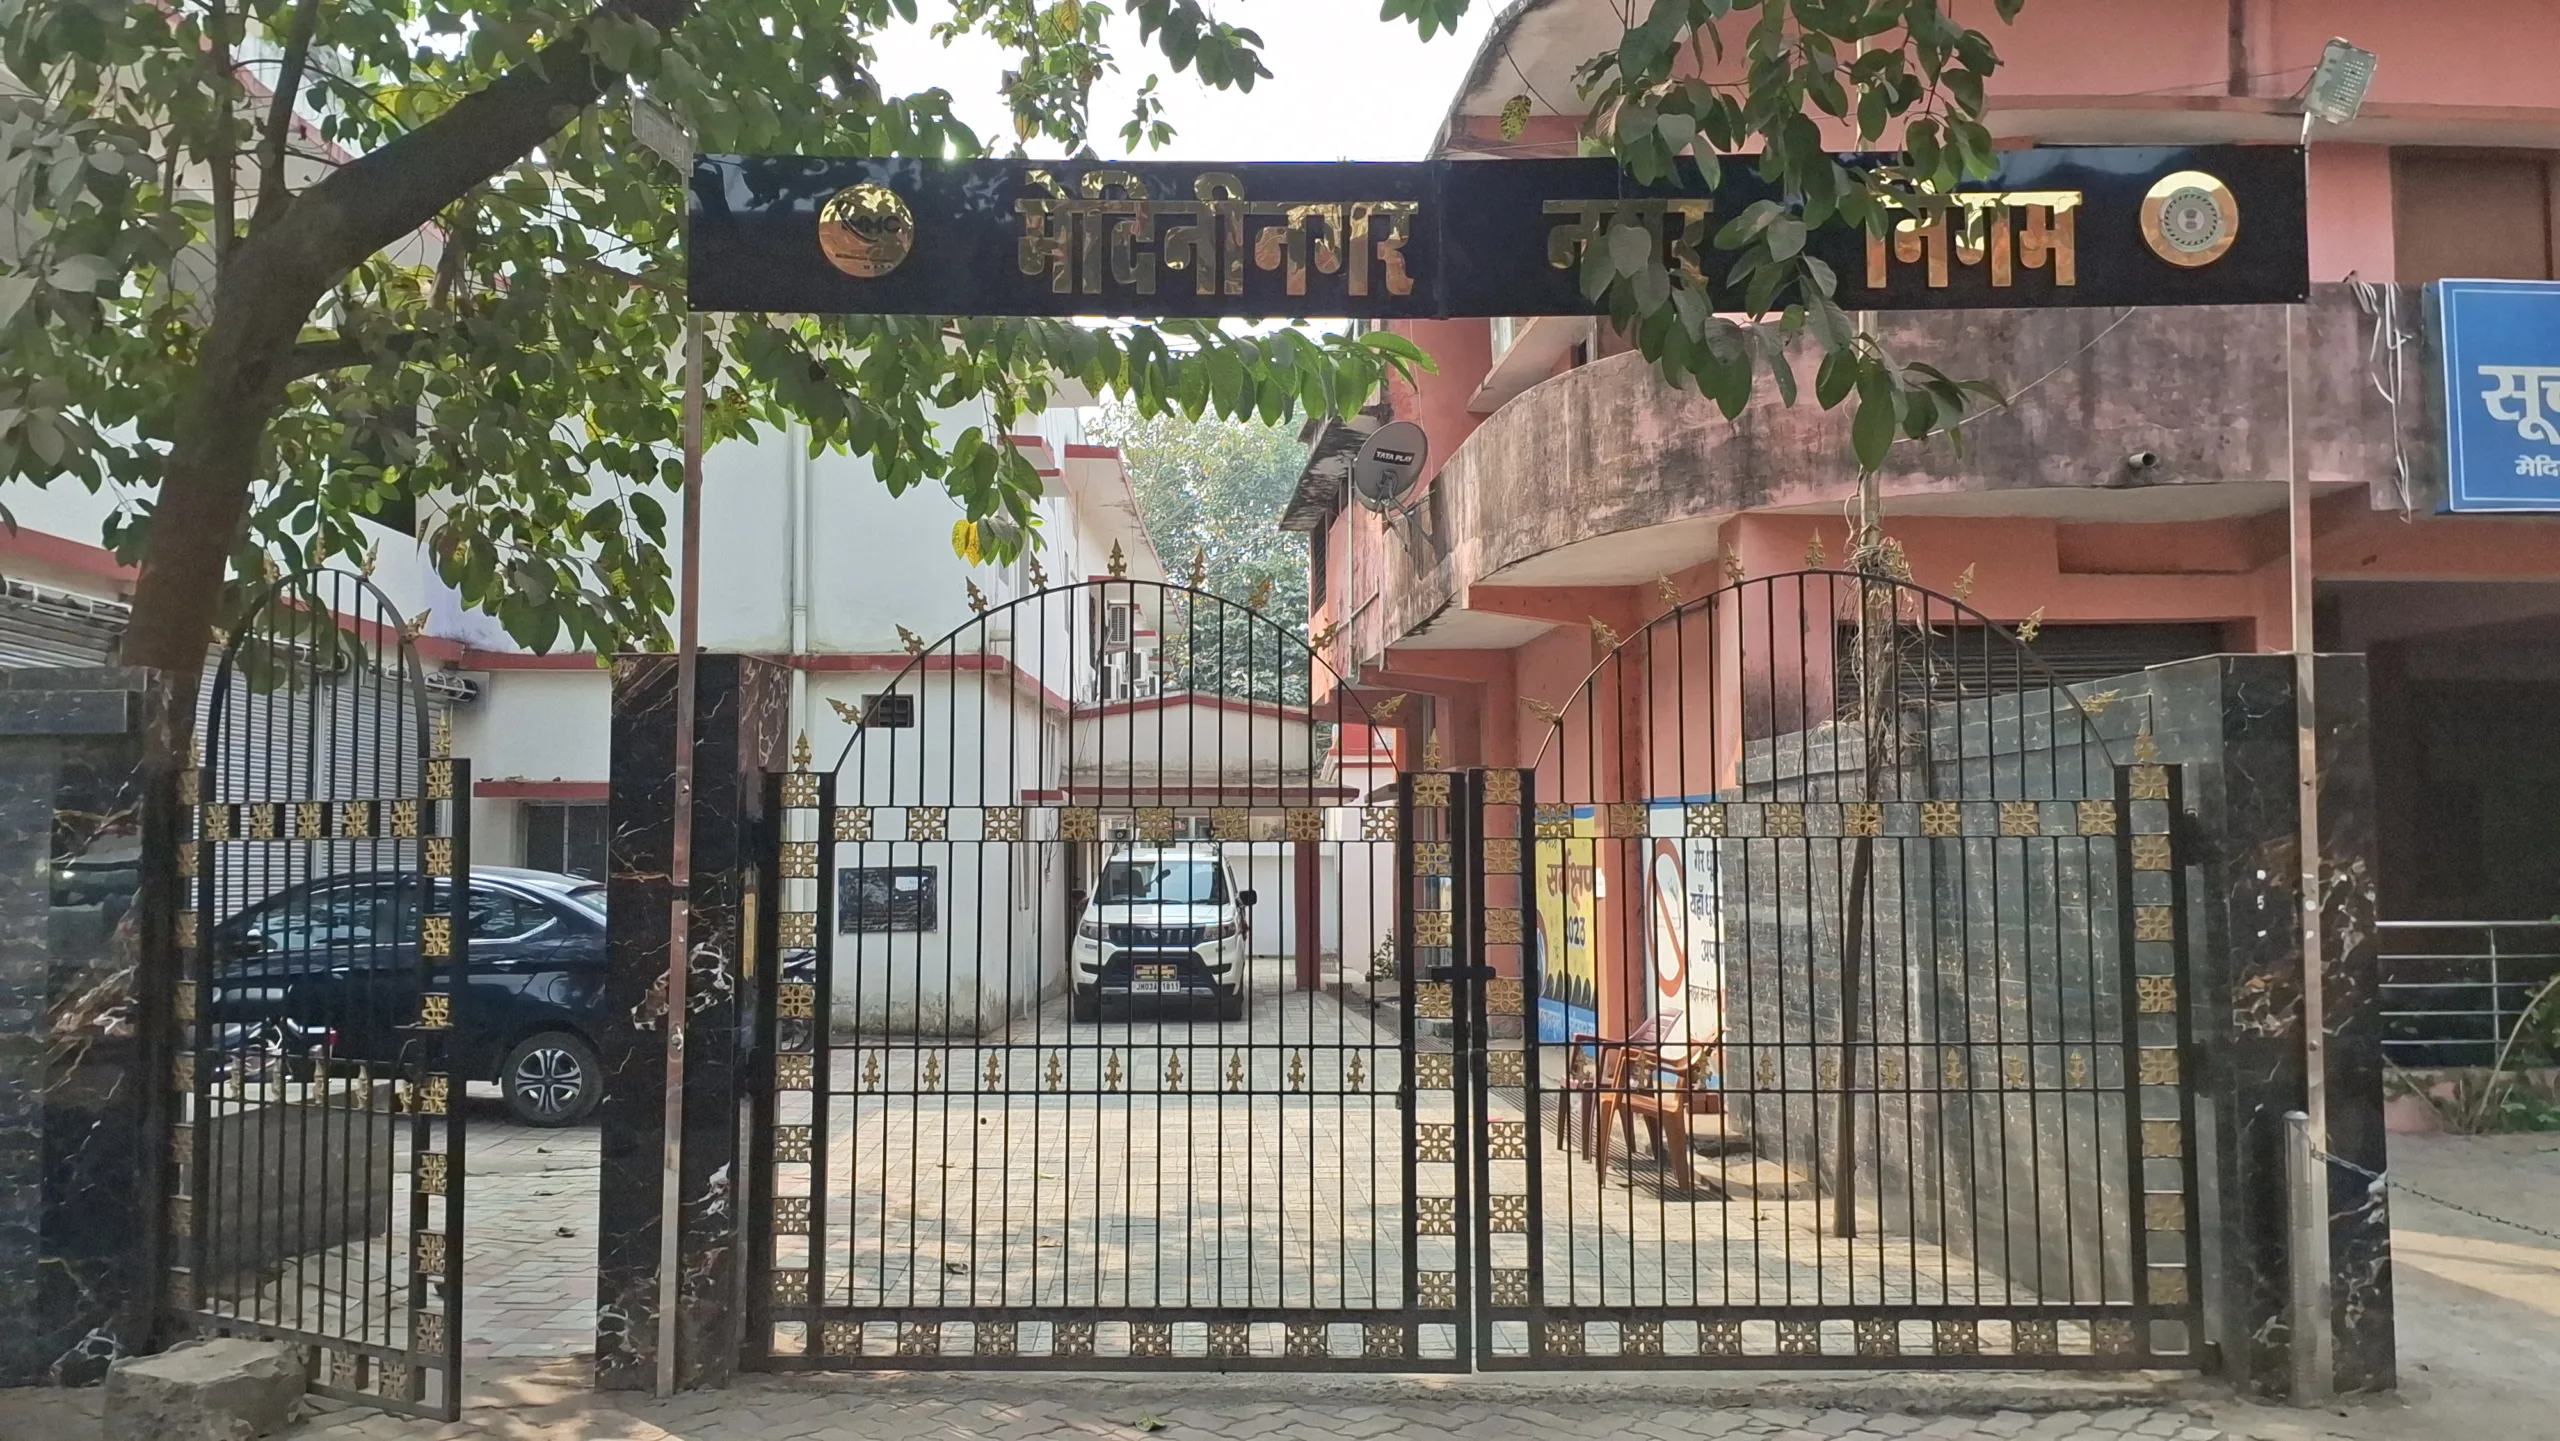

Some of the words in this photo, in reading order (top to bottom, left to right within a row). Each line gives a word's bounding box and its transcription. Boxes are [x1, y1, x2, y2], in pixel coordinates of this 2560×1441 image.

[1014, 170, 1418, 296] मेदिनीनगर
[1376, 451, 1394, 461] TATA
[1395, 453, 1412, 463] PLAY
[1565, 916, 1586, 947] 023
